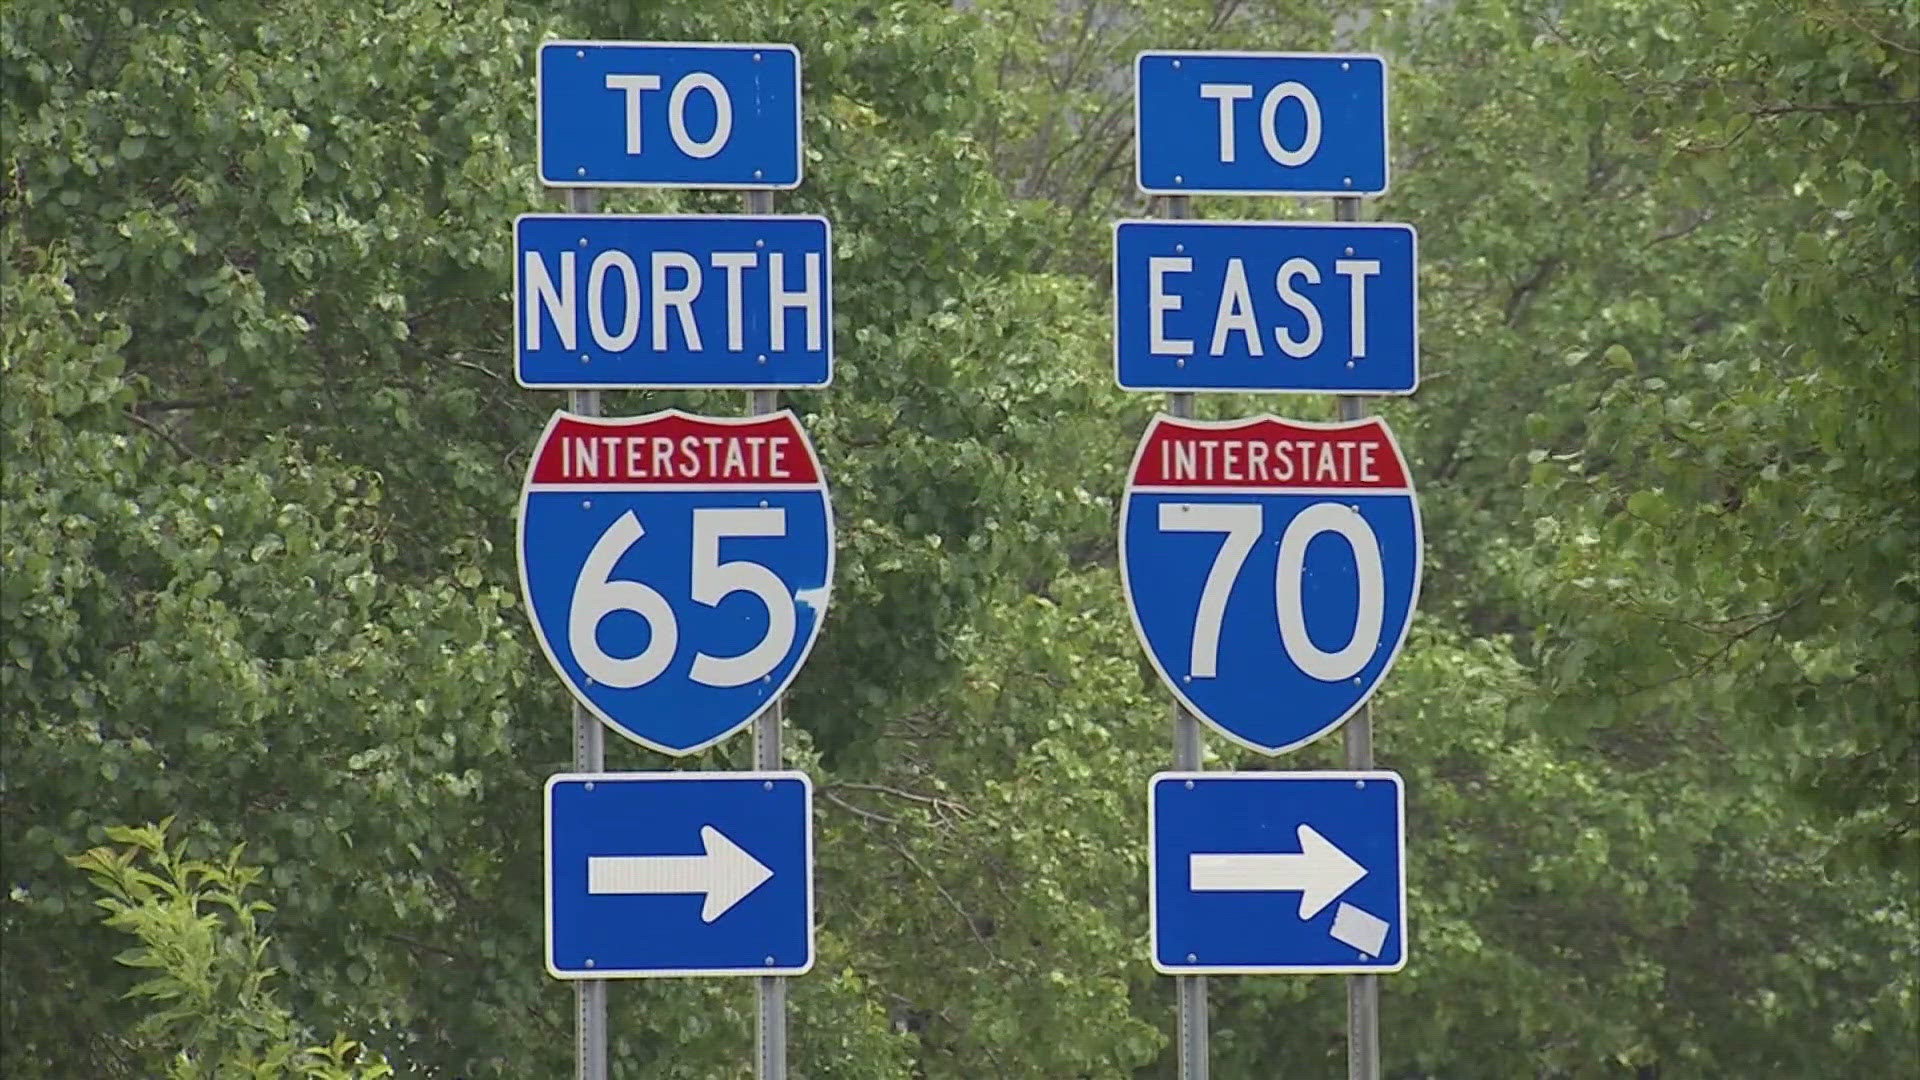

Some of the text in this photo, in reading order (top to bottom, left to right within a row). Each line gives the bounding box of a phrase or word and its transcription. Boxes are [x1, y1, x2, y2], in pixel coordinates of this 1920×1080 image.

[605, 72, 733, 159] TO
[1200, 81, 1322, 167] TO
[525, 249, 822, 353] NORTH
[1149, 257, 1381, 358] EAST
[560, 436, 790, 479] INTERSTATE
[1160, 439, 1381, 482] INTERSTATE
[568, 506, 797, 689] 65
[1158, 502, 1385, 682] 70
